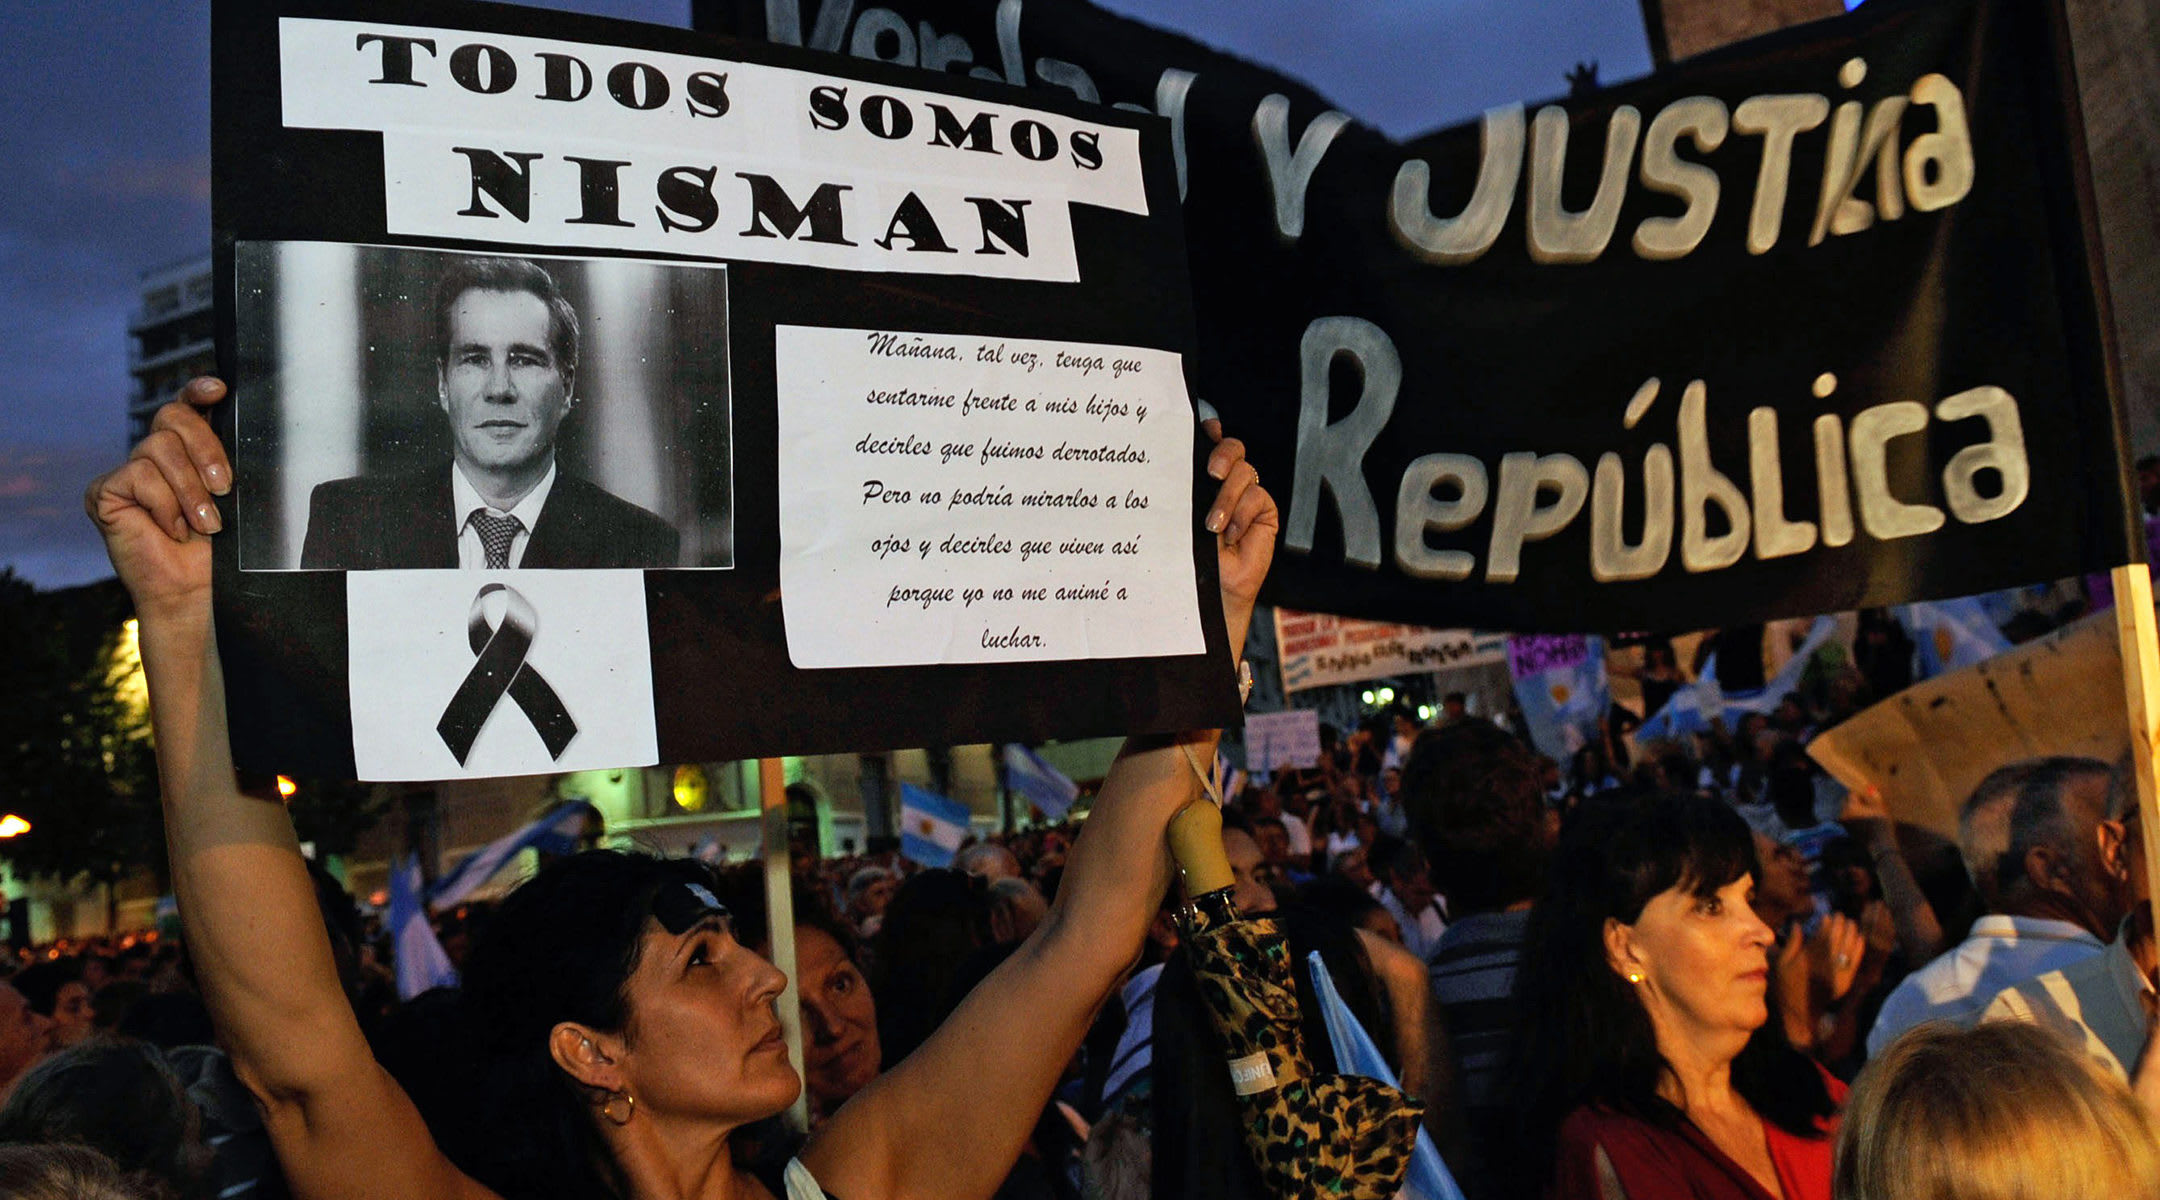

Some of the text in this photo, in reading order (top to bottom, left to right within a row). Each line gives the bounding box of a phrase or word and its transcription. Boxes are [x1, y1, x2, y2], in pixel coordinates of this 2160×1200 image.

[357, 33, 1104, 171] TODOS SOMOS
[452, 146, 1032, 259] NISMAN
[976, 343, 1005, 364] tal
[1056, 351, 1104, 377] tenga
[1112, 359, 1142, 379] que
[866, 388, 1147, 423] sentarme frente a mis hijos y
[855, 432, 931, 456] decirles
[940, 443, 974, 465] que
[980, 437, 1044, 466] fuimos
[862, 480, 1148, 511] Pero no podría mirarlos a los
[871, 533, 1141, 562] ojos y decirles que viven así
[886, 580, 1127, 609] porque yo no me animé a
[982, 627, 1047, 648] luchar.
